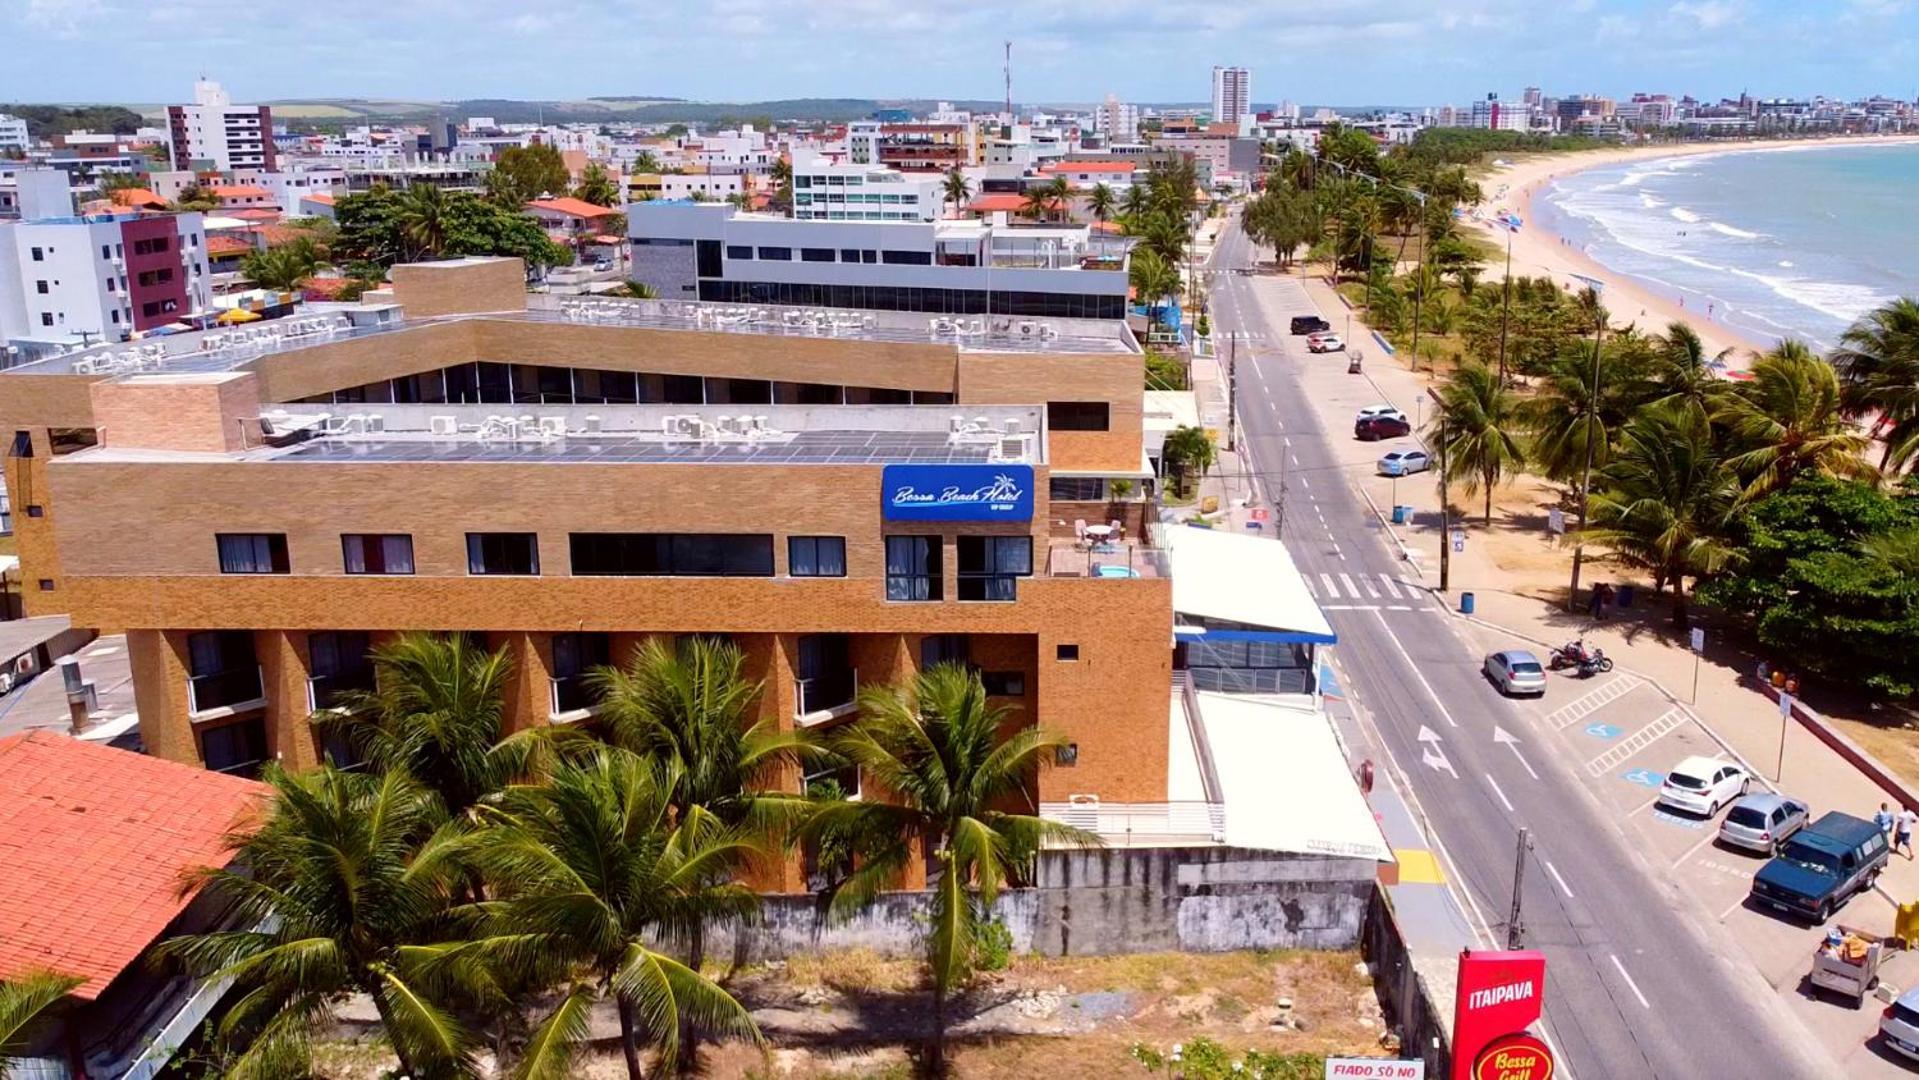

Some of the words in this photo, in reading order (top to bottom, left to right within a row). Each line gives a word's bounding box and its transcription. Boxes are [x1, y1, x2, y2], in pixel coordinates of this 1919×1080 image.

[892, 486, 934, 503] Bessa
[938, 486, 980, 503] Beach
[979, 486, 1023, 502] Hotel
[1469, 980, 1533, 1010] ITAIPAVA
[1495, 1052, 1536, 1070] Bessa
[1334, 1065, 1373, 1076] FIADO
[1398, 1067, 1416, 1078] NO
